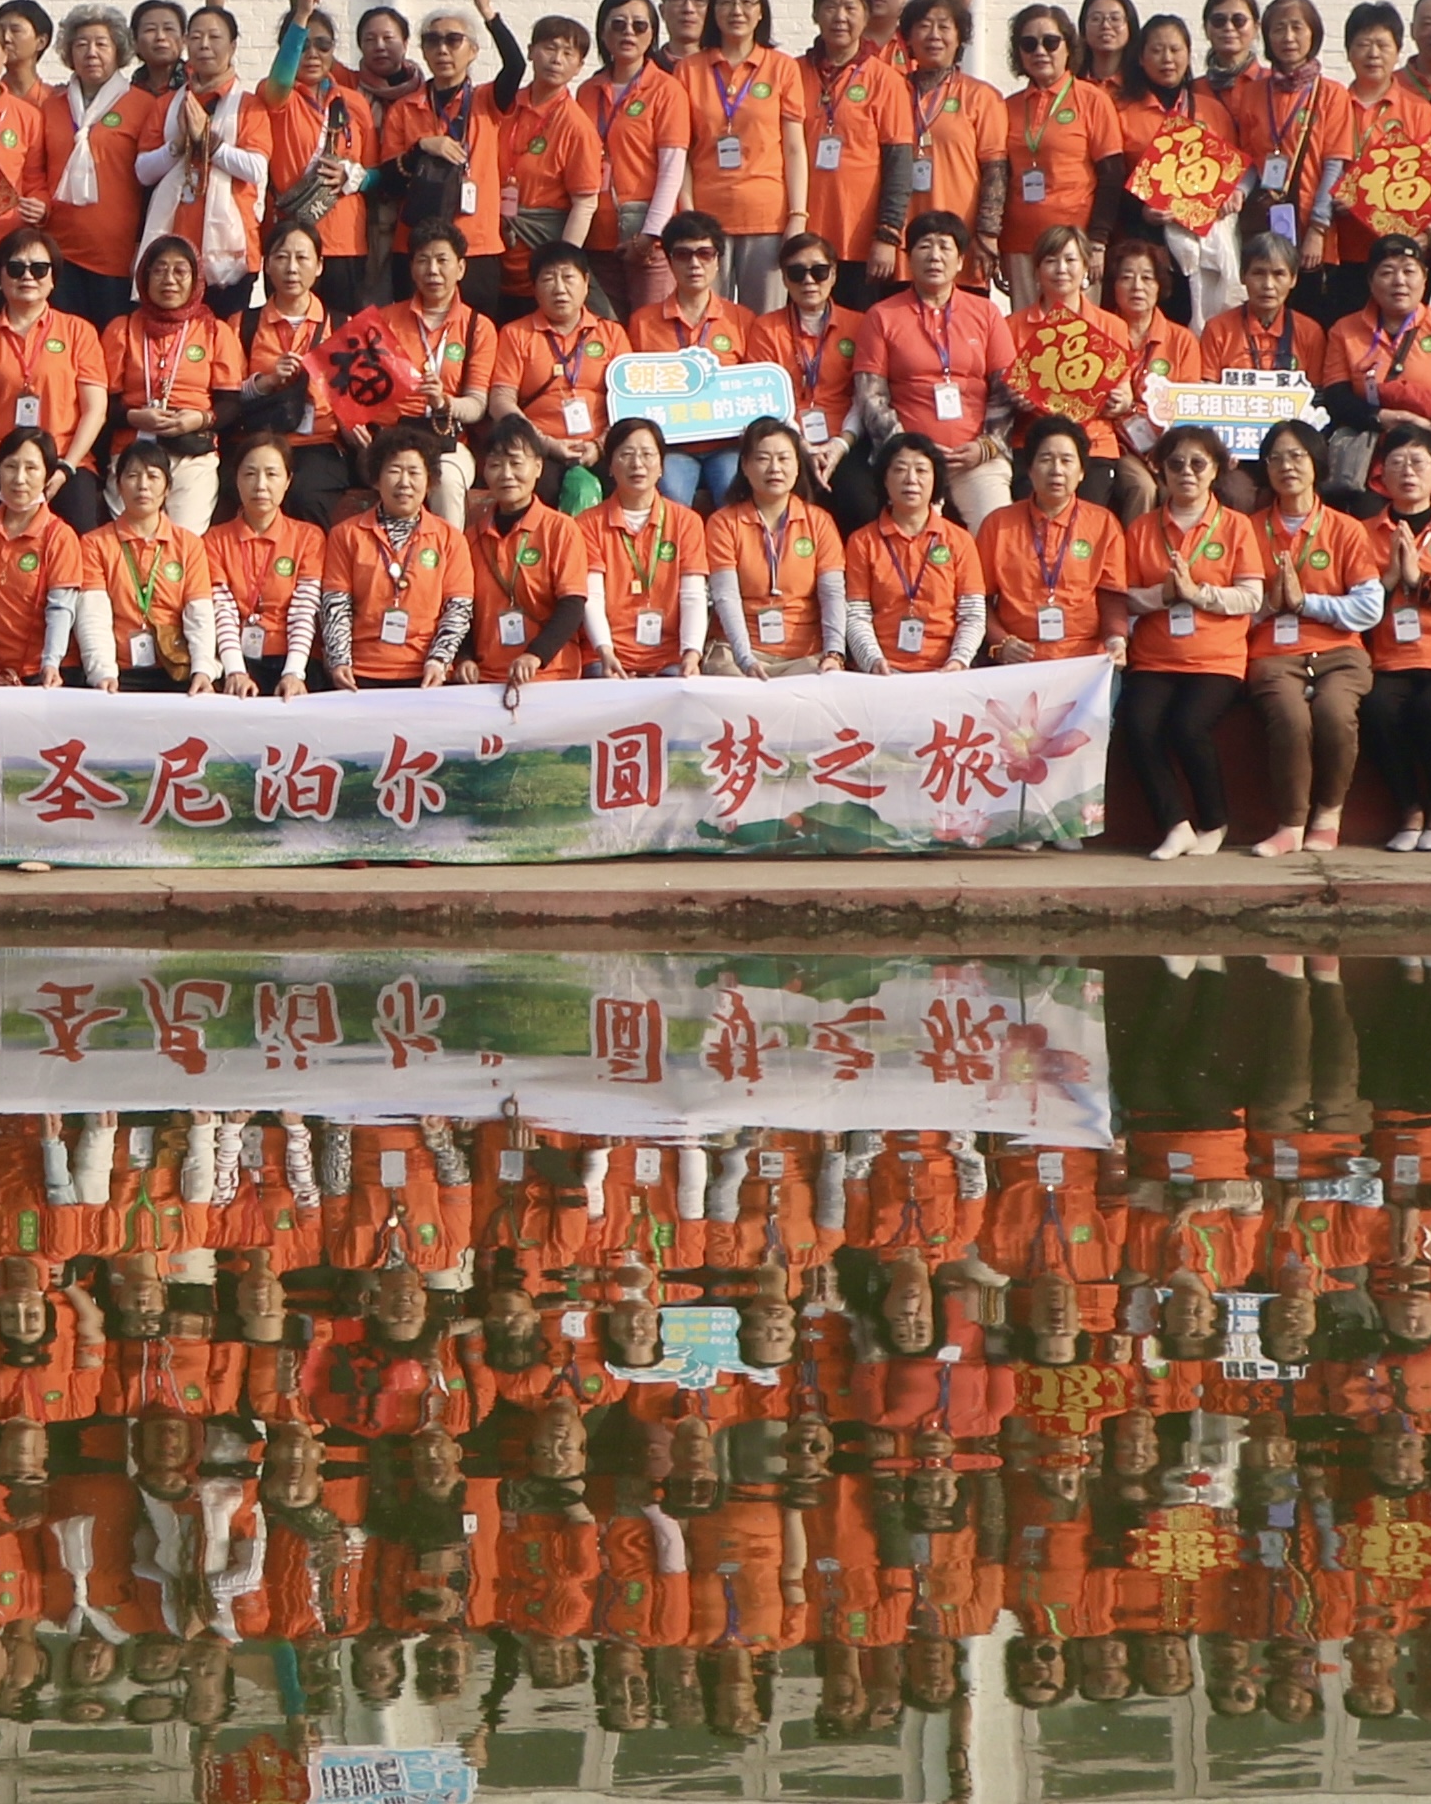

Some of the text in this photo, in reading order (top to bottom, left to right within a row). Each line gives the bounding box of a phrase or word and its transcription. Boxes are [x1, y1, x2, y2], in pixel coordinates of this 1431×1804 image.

[1150, 126, 1221, 199] 福
[624, 361, 690, 394] 朝圣
[1030, 319, 1104, 394] 福
[1224, 370, 1310, 388] 慧缘一家人
[1176, 393, 1295, 419] 佛祖诞生地
[596, 713, 1009, 818] 圆梦之旅
